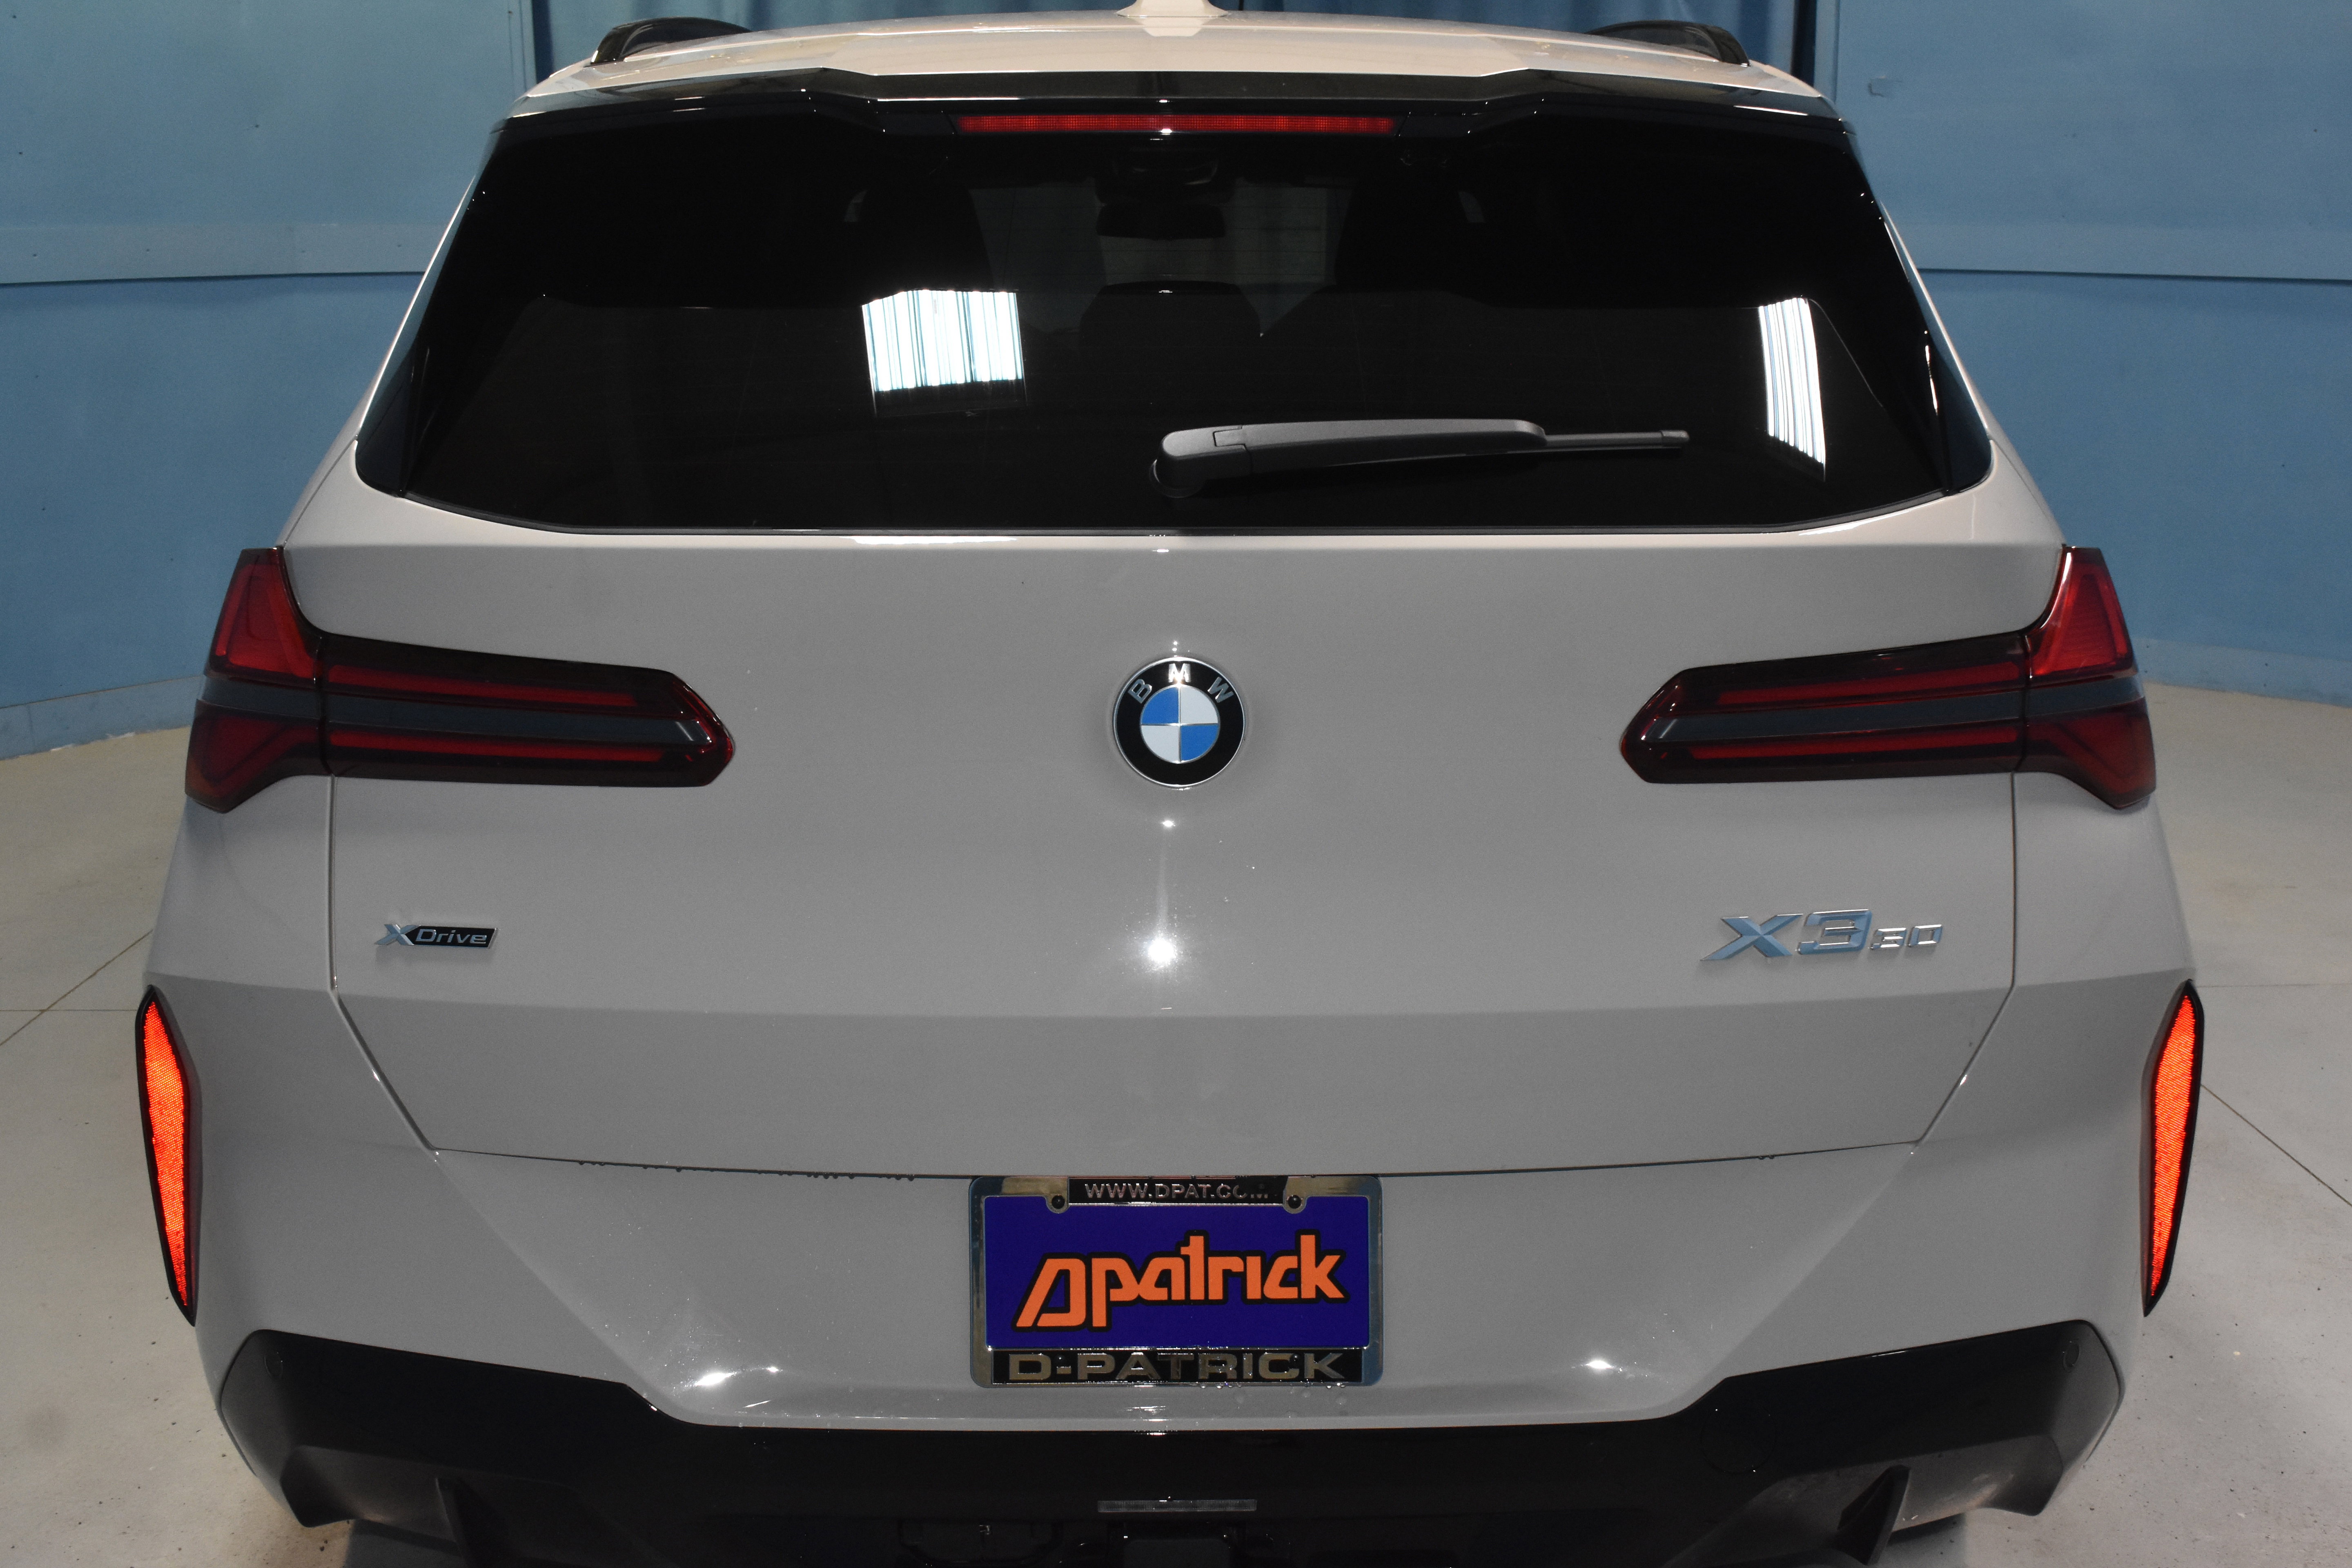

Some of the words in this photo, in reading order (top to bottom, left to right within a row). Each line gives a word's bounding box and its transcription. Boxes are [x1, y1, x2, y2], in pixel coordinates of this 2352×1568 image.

[1127, 663, 1234, 704] BMW
[1085, 1183, 1268, 1199] WWW.DPAT.CO
[1008, 1352, 1346, 1381] D-PATRICK
